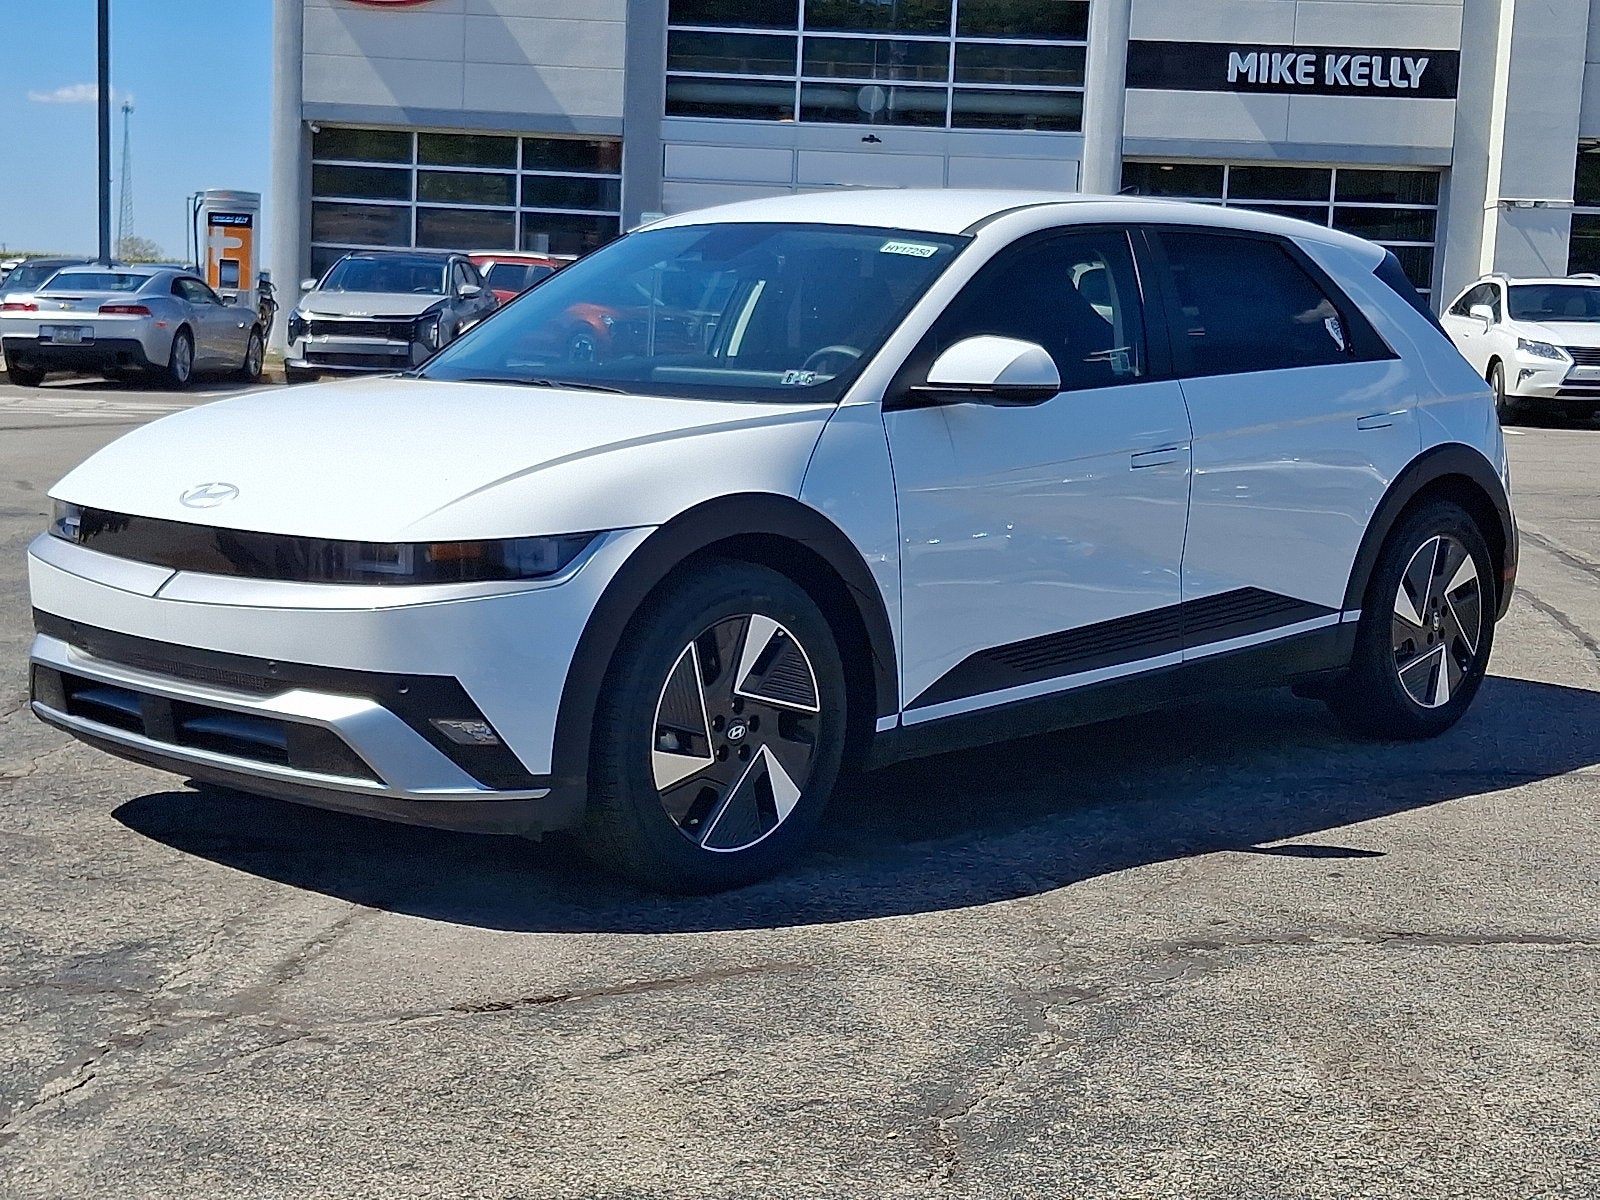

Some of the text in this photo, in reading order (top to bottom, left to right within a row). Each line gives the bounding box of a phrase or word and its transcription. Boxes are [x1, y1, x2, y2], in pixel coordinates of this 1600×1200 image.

[1227, 51, 1429, 88] MIKE KELLY
[884, 244, 931, 256] HY17250
